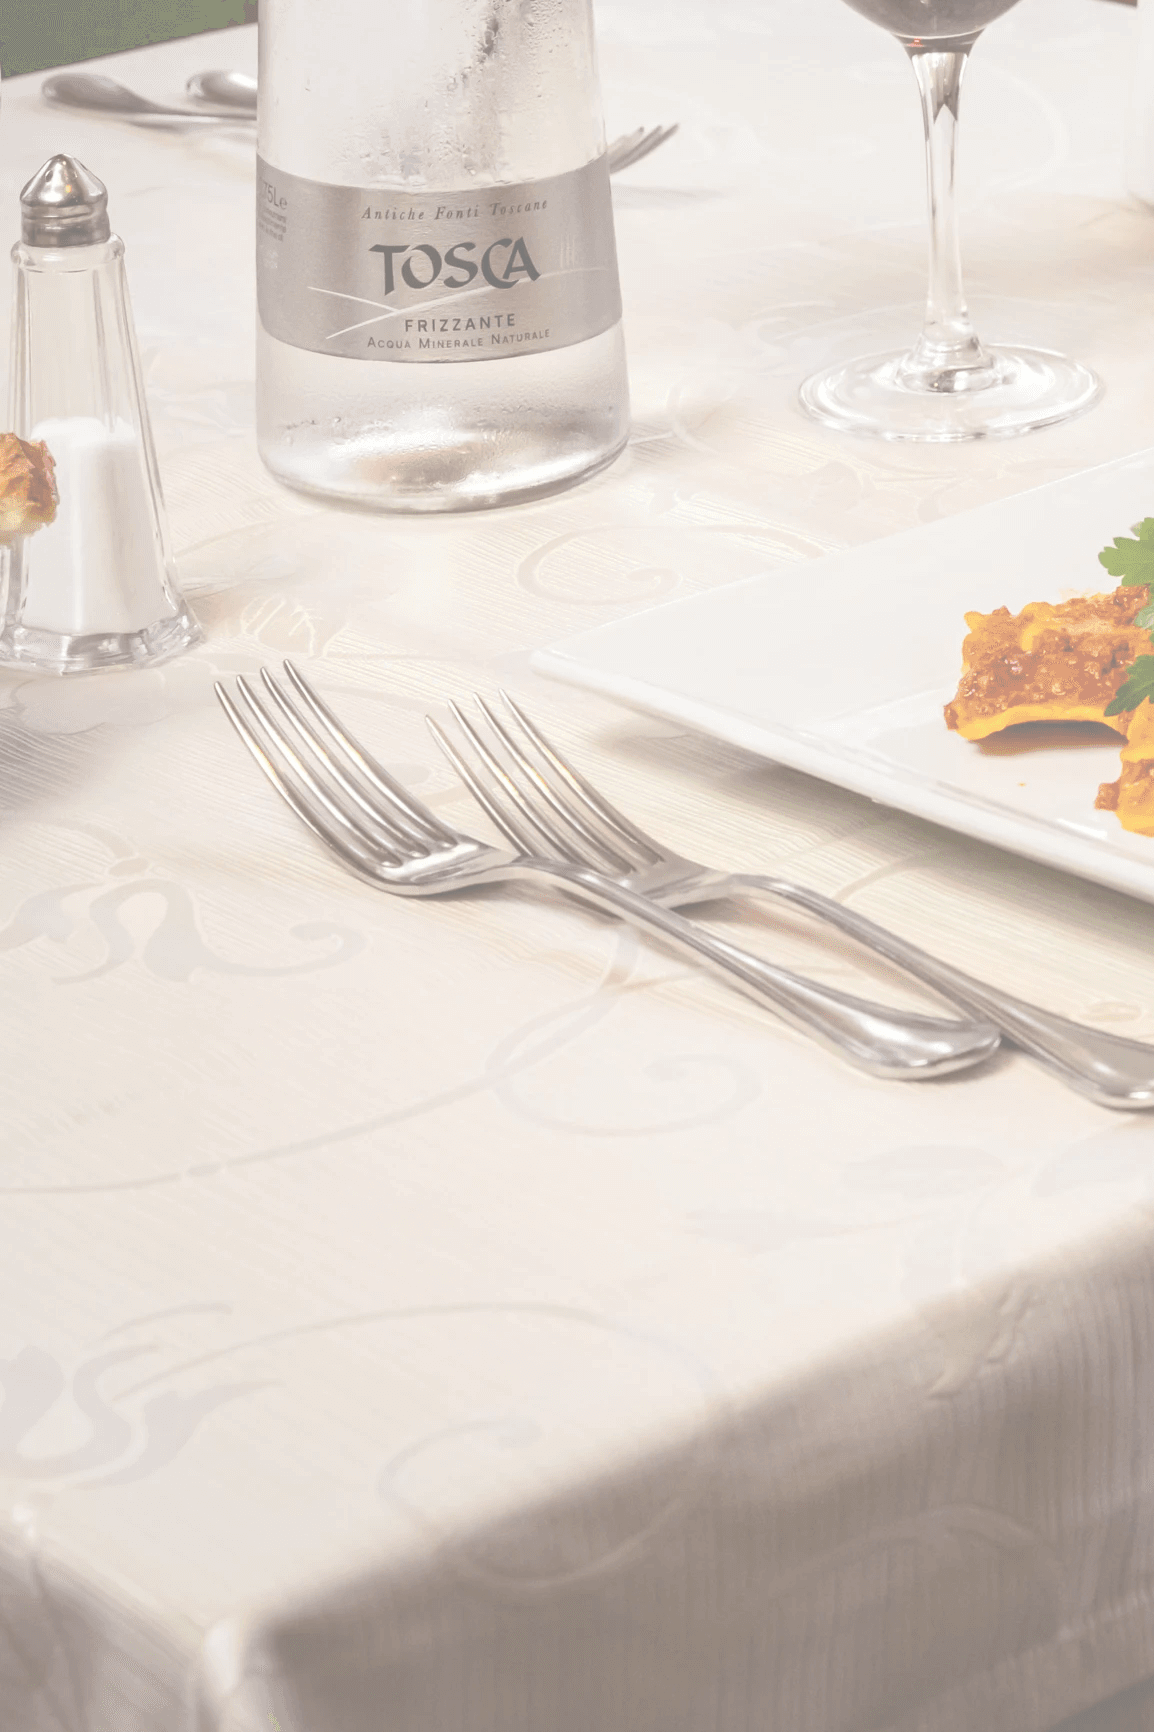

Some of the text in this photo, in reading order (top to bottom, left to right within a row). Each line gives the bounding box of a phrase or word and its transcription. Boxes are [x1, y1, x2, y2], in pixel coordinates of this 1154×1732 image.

[361, 199, 549, 221] Antiche Fonti Toscane
[368, 236, 542, 296] TOSCA
[404, 313, 517, 333] FRIZZANTE
[367, 328, 550, 349] ACQUA MINERALE NATURALE
